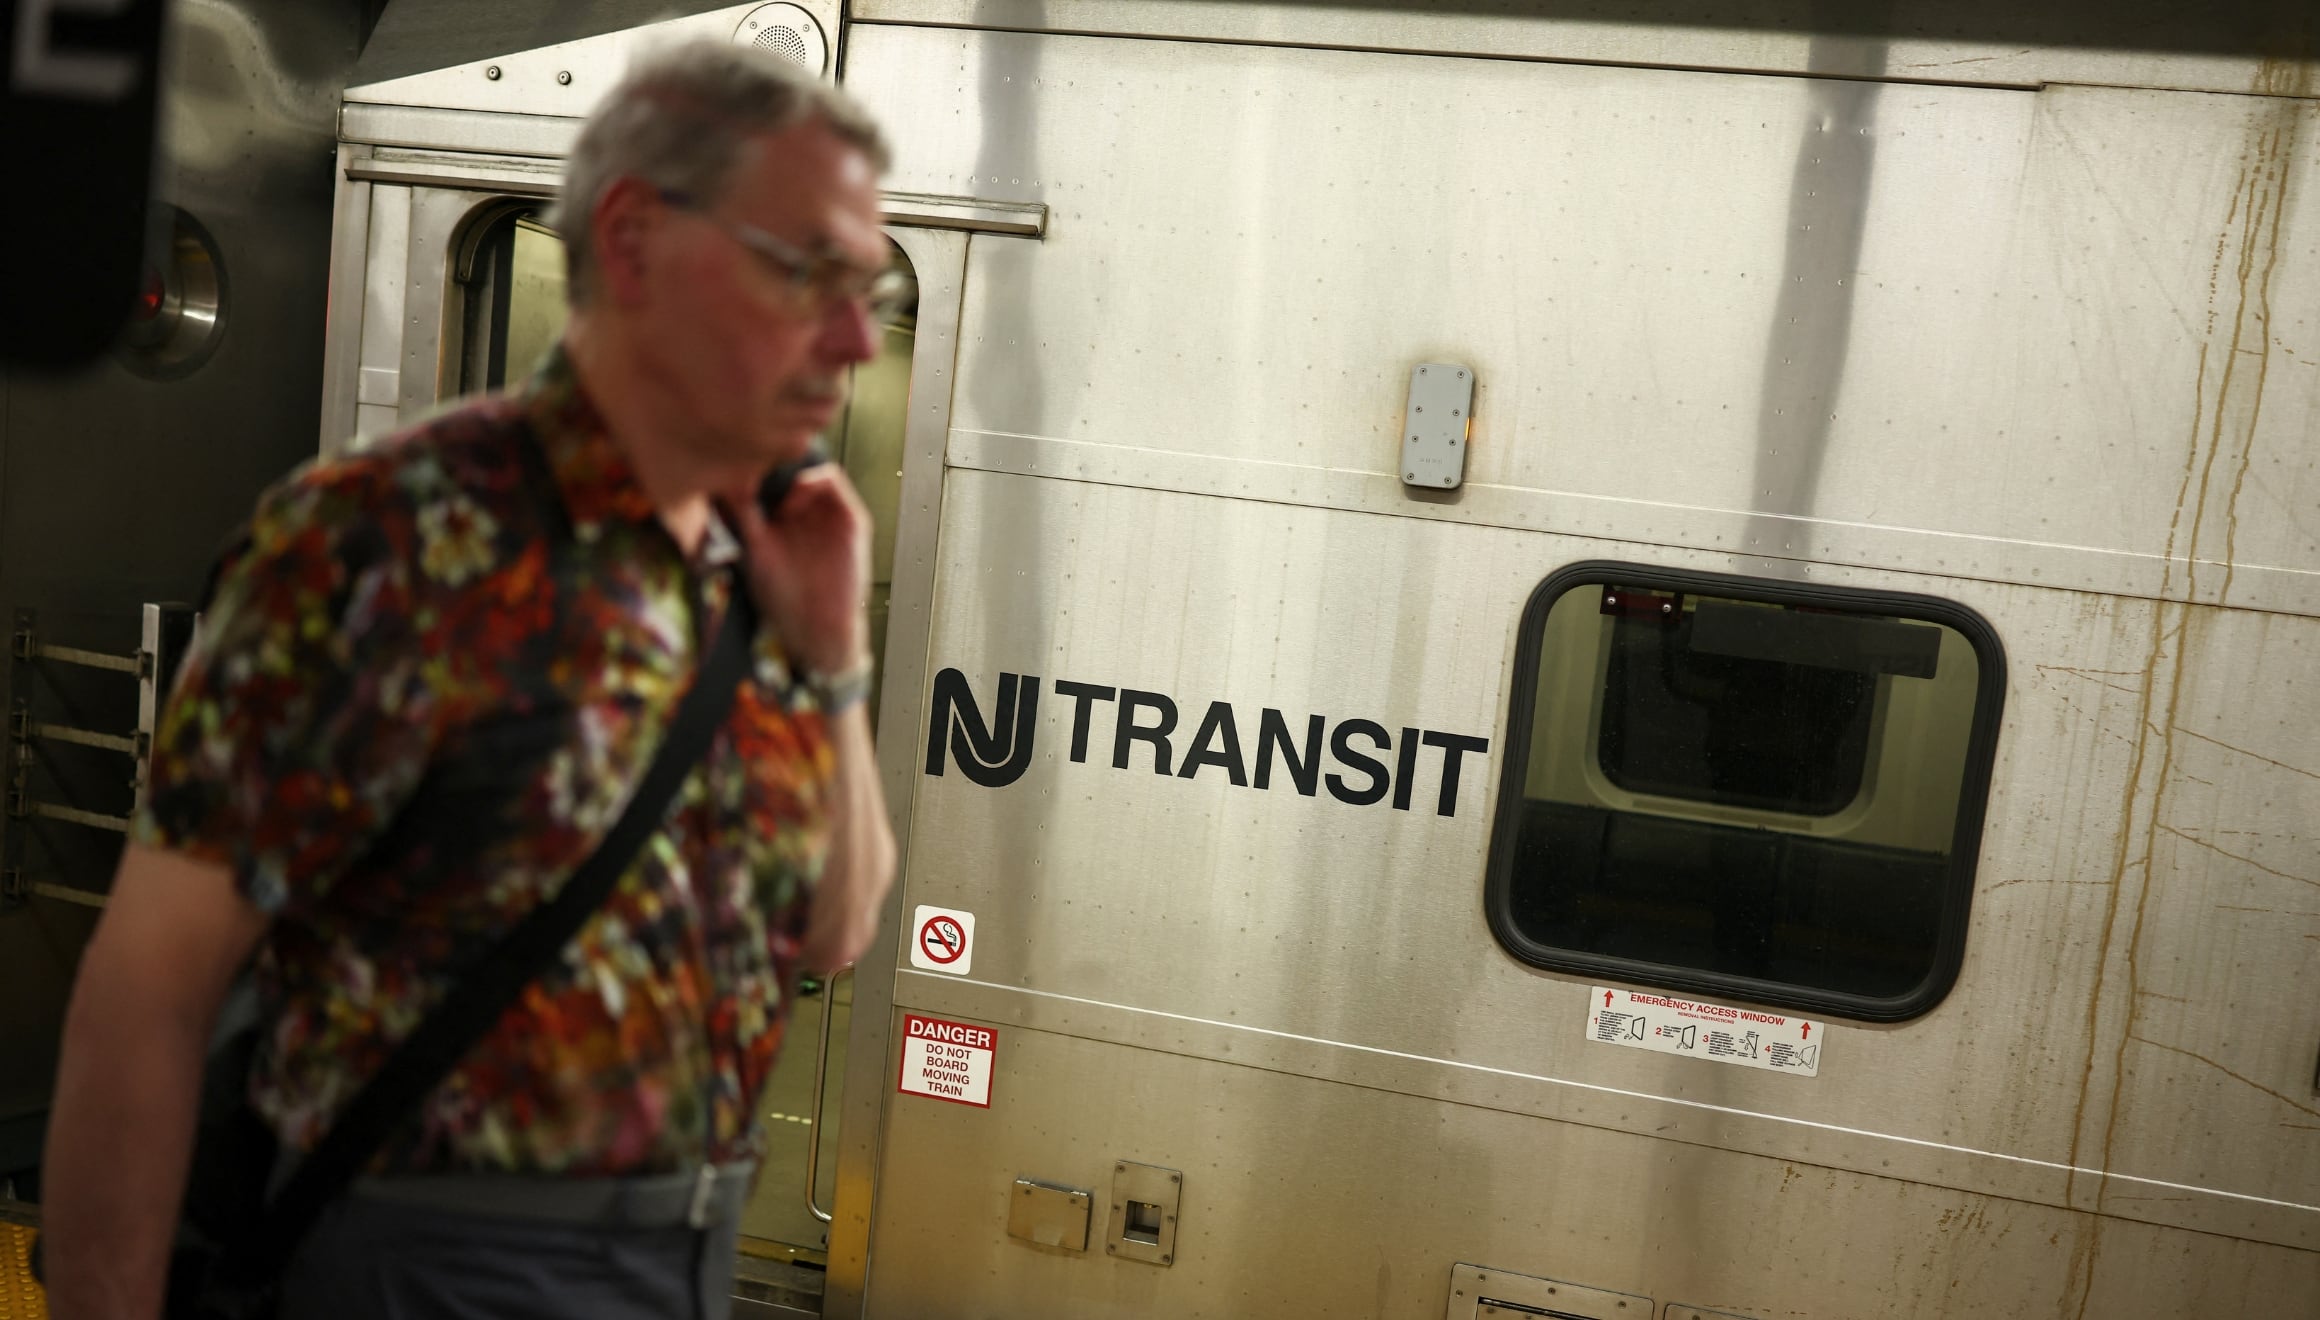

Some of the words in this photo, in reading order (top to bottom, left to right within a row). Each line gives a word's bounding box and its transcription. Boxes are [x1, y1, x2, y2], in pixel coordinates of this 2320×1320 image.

[925, 667, 1041, 787] NJ
[1055, 679, 1490, 818] TRANSIT
[1630, 993, 1695, 1011] EMERGENCY
[1696, 1004, 1738, 1018] ACCESS
[1740, 1011, 1786, 1026] WINDOW
[1677, 1011, 1699, 1019] REMOVAL
[1700, 1015, 1735, 1024] INSTRUCTIONS
[910, 1019, 991, 1047] DANGER
[1655, 1027, 1662, 1035] 2
[1702, 1034, 1709, 1043] 3
[926, 1043, 944, 1055] DO
[946, 1047, 972, 1060] NOT
[1764, 1045, 1771, 1053] 4
[926, 1056, 969, 1072] BOARD
[922, 1068, 970, 1085] MOVING
[927, 1081, 963, 1097] TRAIN
